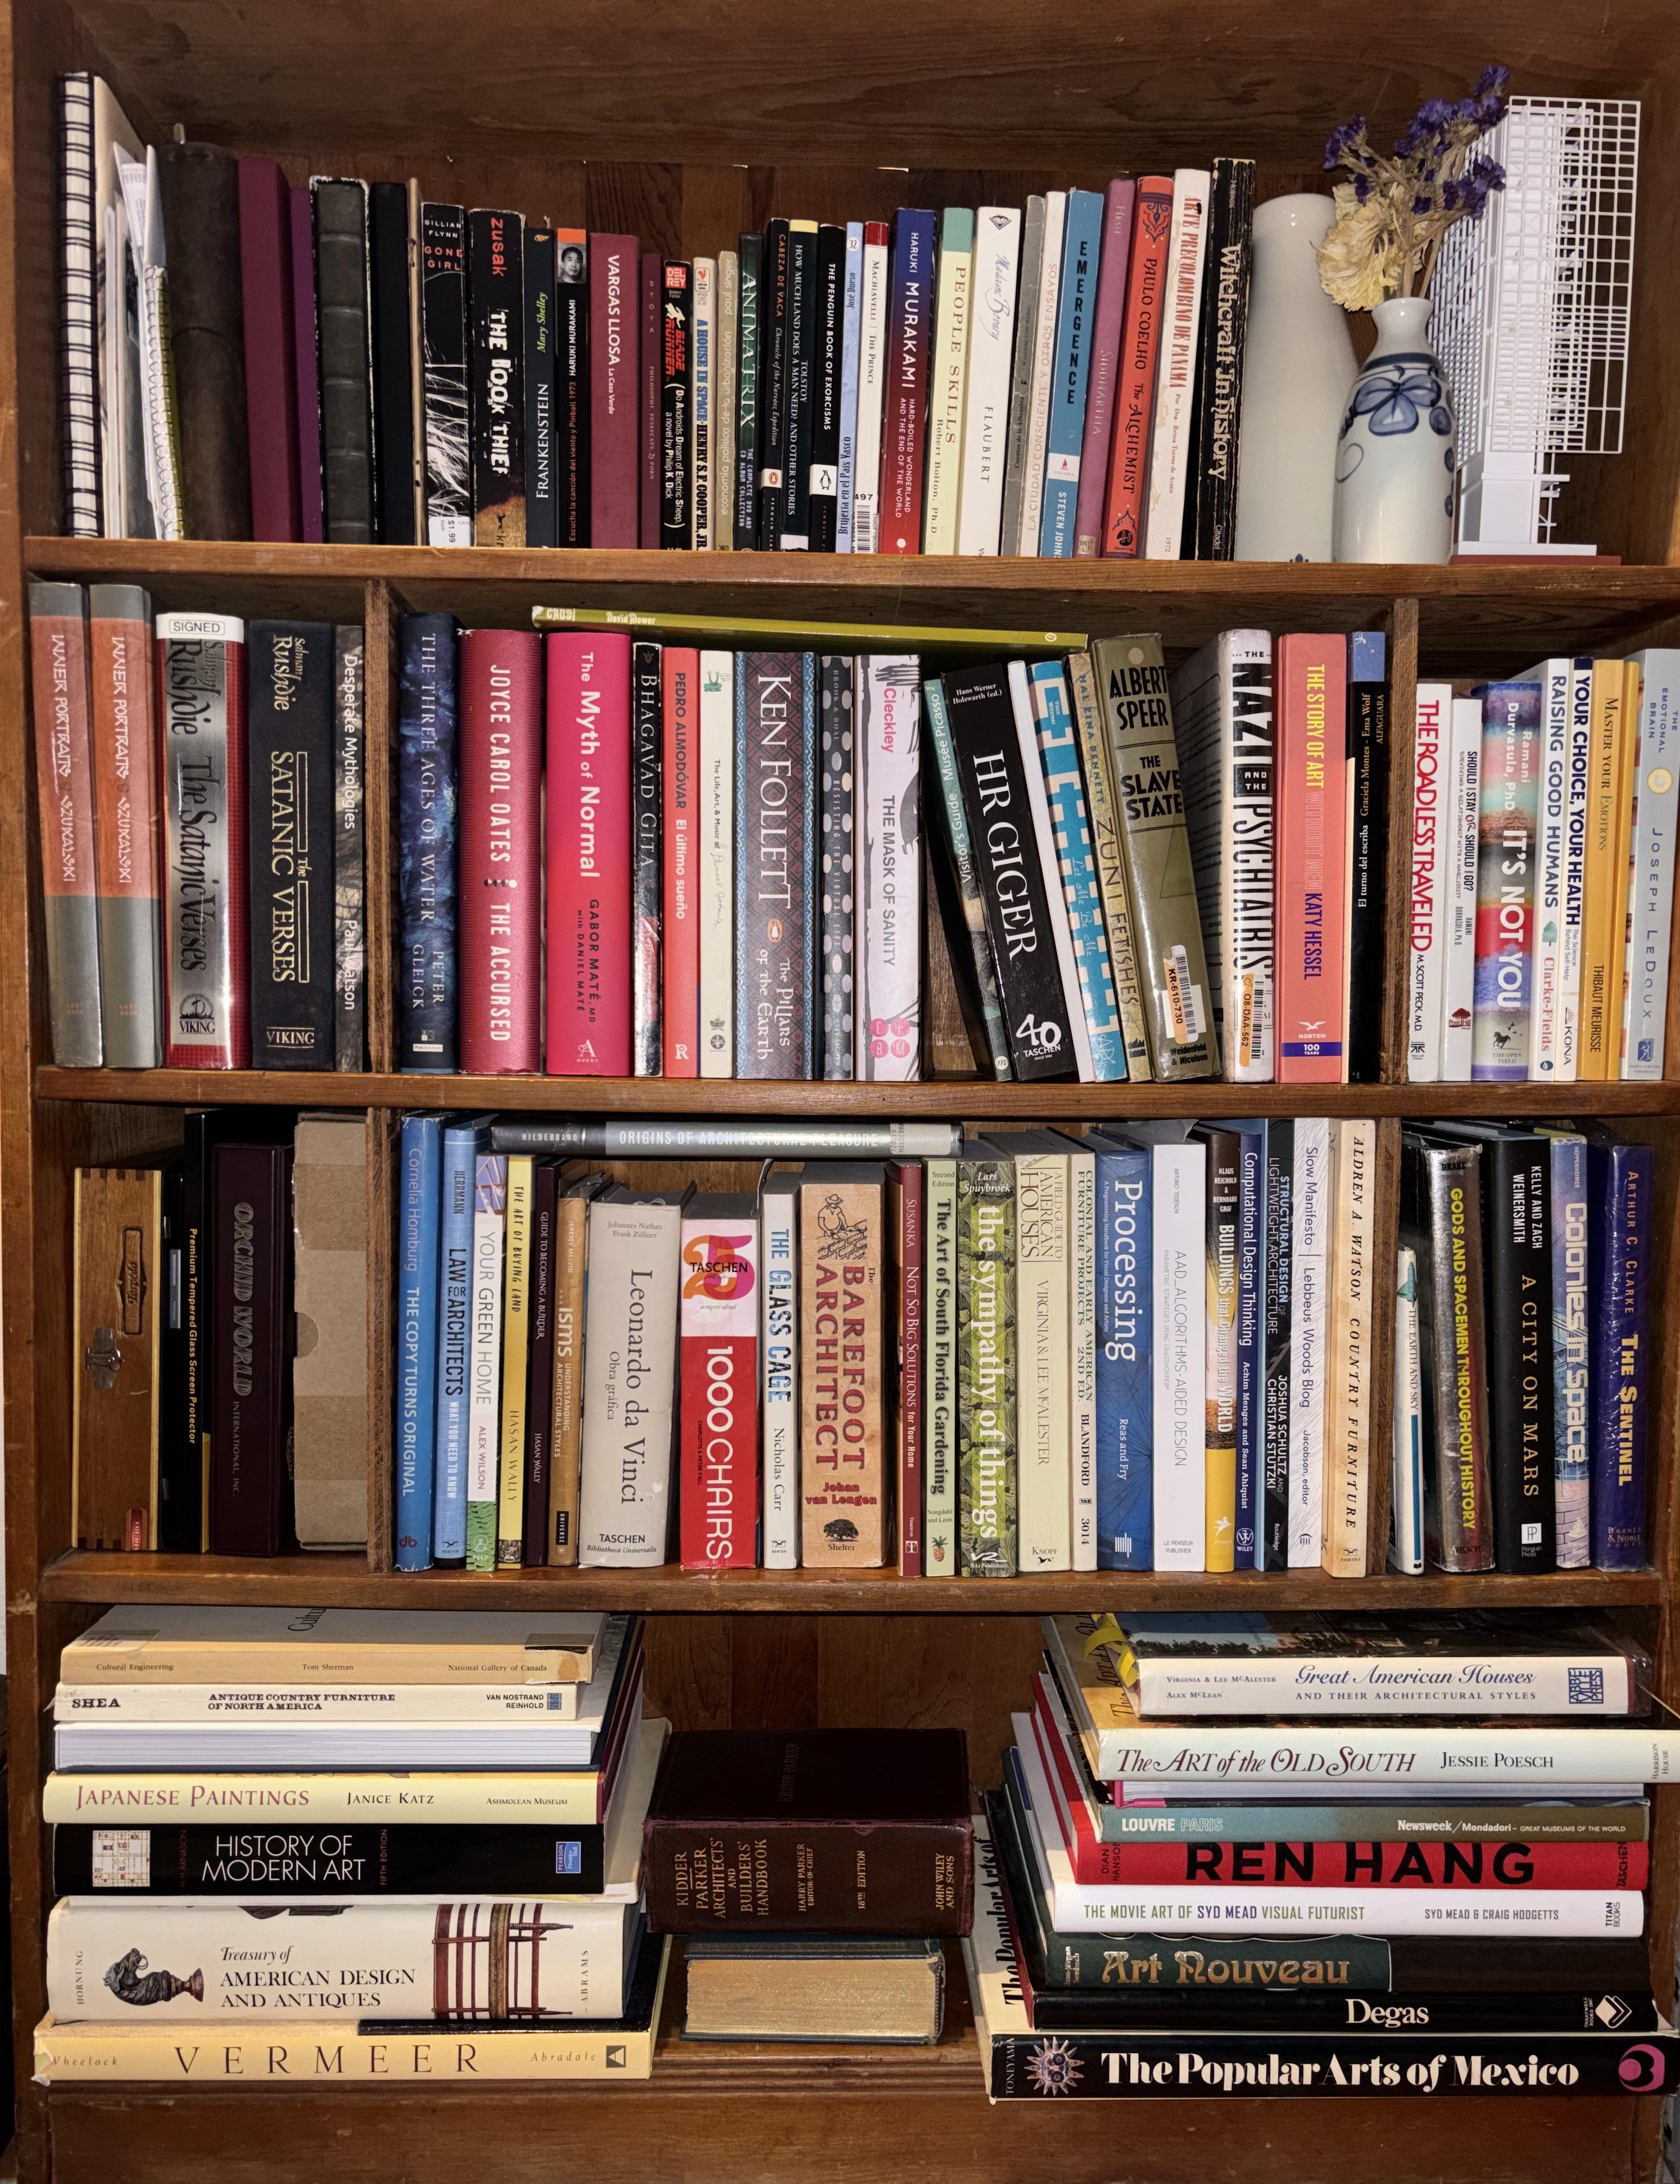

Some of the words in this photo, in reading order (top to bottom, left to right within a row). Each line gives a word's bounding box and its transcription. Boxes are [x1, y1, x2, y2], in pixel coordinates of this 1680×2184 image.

[424, 220, 461, 228] GILLIAN
[424, 247, 463, 256] GONE
[428, 260, 461, 270] GIRL
[777, 234, 786, 272] CABEZA
[909, 232, 920, 274] HARUKI
[608, 255, 619, 316] VARGAS
[777, 275, 784, 289] DE
[1142, 259, 1157, 306] PAULO
[537, 292, 546, 322] Shelley
[951, 266, 966, 354] PEOPLE
[1067, 241, 1088, 405] EMERGENCE
[489, 310, 509, 351] THE
[537, 324, 546, 353] Mary
[608, 319, 619, 365] LLOSA
[742, 272, 757, 429] ANIMATRIX
[902, 282, 918, 389] MURAKAMI
[1135, 311, 1151, 370] COELHO
[826, 359, 832, 373] OF
[945, 365, 961, 445] SKILLS
[1135, 383, 1144, 399] The
[490, 422, 509, 477] THIEF
[536, 384, 549, 499] FRANKENSTEIN
[980, 406, 993, 484] FLAUBERT
[1121, 404, 1142, 494] ALCHEMIST
[173, 622, 220, 633] SIGNED
[270, 635, 302, 711] Rushdie
[421, 633, 436, 675] THE
[581, 653, 594, 682] The
[343, 655, 357, 733] Desperate
[490, 664, 510, 724] JOYCE
[1109, 665, 1167, 699] ALBERT
[1307, 665, 1324, 694] THE
[421, 683, 436, 750] THREE
[576, 691, 601, 755] Myth
[757, 675, 791, 748] KEN
[881, 688, 896, 753] Cleckley
[1117, 701, 1168, 730] SPEER
[1306, 695, 1324, 740] STORY
[1550, 676, 1566, 752] RAISING
[640, 674, 656, 799] BHAGAVAD
[1306, 741, 1324, 762] OF
[343, 737, 356, 829] Mythologies
[421, 758, 436, 810] AGES
[490, 731, 510, 793] CAROL
[581, 761, 593, 779] of
[973, 750, 1011, 816] HR
[1120, 774, 1180, 795] SLAVE
[1139, 756, 1161, 768] THE
[1305, 763, 1324, 788] ART
[882, 794, 895, 827] THE
[1126, 798, 1182, 820] STATE
[1547, 760, 1563, 818] GOOD
[271, 752, 295, 876] SATANIC
[421, 819, 436, 843] OF
[490, 795, 510, 862] OATES
[579, 786, 600, 878] Normal
[758, 760, 791, 908] FOLLETT
[640, 812, 656, 867] GITA
[882, 831, 895, 879] MASK
[420, 854, 436, 922] WATER
[1545, 826, 1561, 908] HUMANS
[882, 882, 895, 906] OF
[987, 822, 1038, 960] GIGER
[1305, 892, 1322, 930] KATY
[271, 887, 295, 984] VERSES
[490, 904, 510, 936] THE
[882, 908, 895, 967] SANITY
[412, 944, 423, 1009] GLEICK
[433, 951, 442, 1004] PETER
[1304, 934, 1322, 980] HESSEL
[490, 945, 510, 1042] ACCURSED
[1168, 968, 1183, 1025] KR-610-730
[266, 1031, 314, 1044] VIKING
[1023, 1044, 1061, 1057] TASCHEN
[407, 1148, 422, 1204] Cornelia
[1307, 1147, 1318, 1177] Slow
[979, 1206, 1004, 1249] the
[1304, 1180, 1316, 1246] Manifesto
[189, 1228, 198, 1274] Premium
[404, 1207, 422, 1272] Homburg
[479, 1231, 496, 1283] YOUR
[1105, 1181, 1142, 1362] Processing
[1521, 1275, 1536, 1290] A
[189, 1276, 198, 1329] Tempered
[406, 1286, 419, 1318] THE
[477, 1288, 494, 1344] GREEN
[1303, 1268, 1315, 1325] Lebbeus
[189, 1330, 198, 1358] Glass
[405, 1322, 419, 1364] COPY
[626, 1269, 653, 1390] Leonardo
[971, 1260, 1005, 1403] sympathy
[1302, 1328, 1314, 1374] Woods
[1521, 1302, 1537, 1364] CITY
[189, 1360, 197, 1395] Screen
[476, 1349, 492, 1406] HOME
[705, 1346, 734, 1434] 1000
[815, 1265, 838, 1469] ARCHITECT
[843, 1266, 864, 1470] BAREFOOT
[404, 1366, 418, 1418] TURNS
[624, 1398, 639, 1428] da
[1301, 1380, 1313, 1408] Blog
[1523, 1376, 1538, 1411] ON
[980, 1409, 1005, 1444] of
[1120, 1419, 1129, 1441] Reas
[402, 1422, 417, 1497] ORIGINAL
[622, 1437, 645, 1506] Vinci
[773, 1428, 785, 1480] Nicholas
[1117, 1463, 1129, 1480] Fry
[1120, 1443, 1129, 1461] and
[1523, 1425, 1538, 1497] MARS
[705, 1439, 733, 1560] CHAIRS
[773, 1481, 784, 1512] Carr
[972, 1451, 1005, 1539] things
[599, 1534, 645, 1543] TASCHEN
[828, 1543, 855, 1552] Shelter
[96, 1663, 126, 1672] Cultural
[129, 1663, 174, 1672] Engineering
[72, 1698, 121, 1708] SHEA
[1440, 1752, 1489, 1769] JESSIE
[1493, 1753, 1554, 1768] POESCH
[76, 1785, 180, 1811] JAPANESE
[191, 1785, 309, 1807] PAINTINGS
[346, 1792, 392, 1806] JANICE
[399, 1792, 434, 1805] KATZ
[216, 1836, 318, 1857] HISTORY
[320, 1834, 352, 1857] OF
[1121, 1818, 1175, 1832] LOUVRE
[1180, 1818, 1222, 1832] PARIS
[202, 1859, 317, 1882] MODERN
[324, 1859, 365, 1880] ART
[676, 1852, 688, 1906] KIDDER
[696, 1847, 708, 1910] PARKER
[755, 1839, 769, 1916] HANDBOOK
[1186, 1843, 1314, 1881] REN
[1345, 1842, 1534, 1885] HANG
[1084, 1905, 1106, 1919] THE
[1110, 1905, 1147, 1919] MOVIE
[1151, 1905, 1174, 1920] ART
[1178, 1905, 1193, 1920] OF
[1197, 1905, 1220, 1920] SYD
[1224, 1905, 1257, 1920] MEAD
[1262, 1905, 1304, 1920] VISUAL
[1307, 1905, 1365, 1920] FUTURIST
[220, 1969, 329, 1987] AMERICAN
[339, 1969, 416, 1986] DESIGN
[1102, 1951, 1161, 1984] Art
[1175, 1950, 1349, 1984] Nouveau
[221, 1992, 265, 2008] AND
[274, 1992, 381, 2009] ANTIQUES
[1346, 1999, 1429, 2028] Degas
[175, 2043, 479, 2075] VERMEER
[1101, 2052, 1172, 2085] The
[1179, 2053, 1320, 2091] Popular
[1321, 2053, 1399, 2087] Arts
[1407, 2054, 1445, 2093] of
[1451, 2055, 1579, 2087] Mexico
